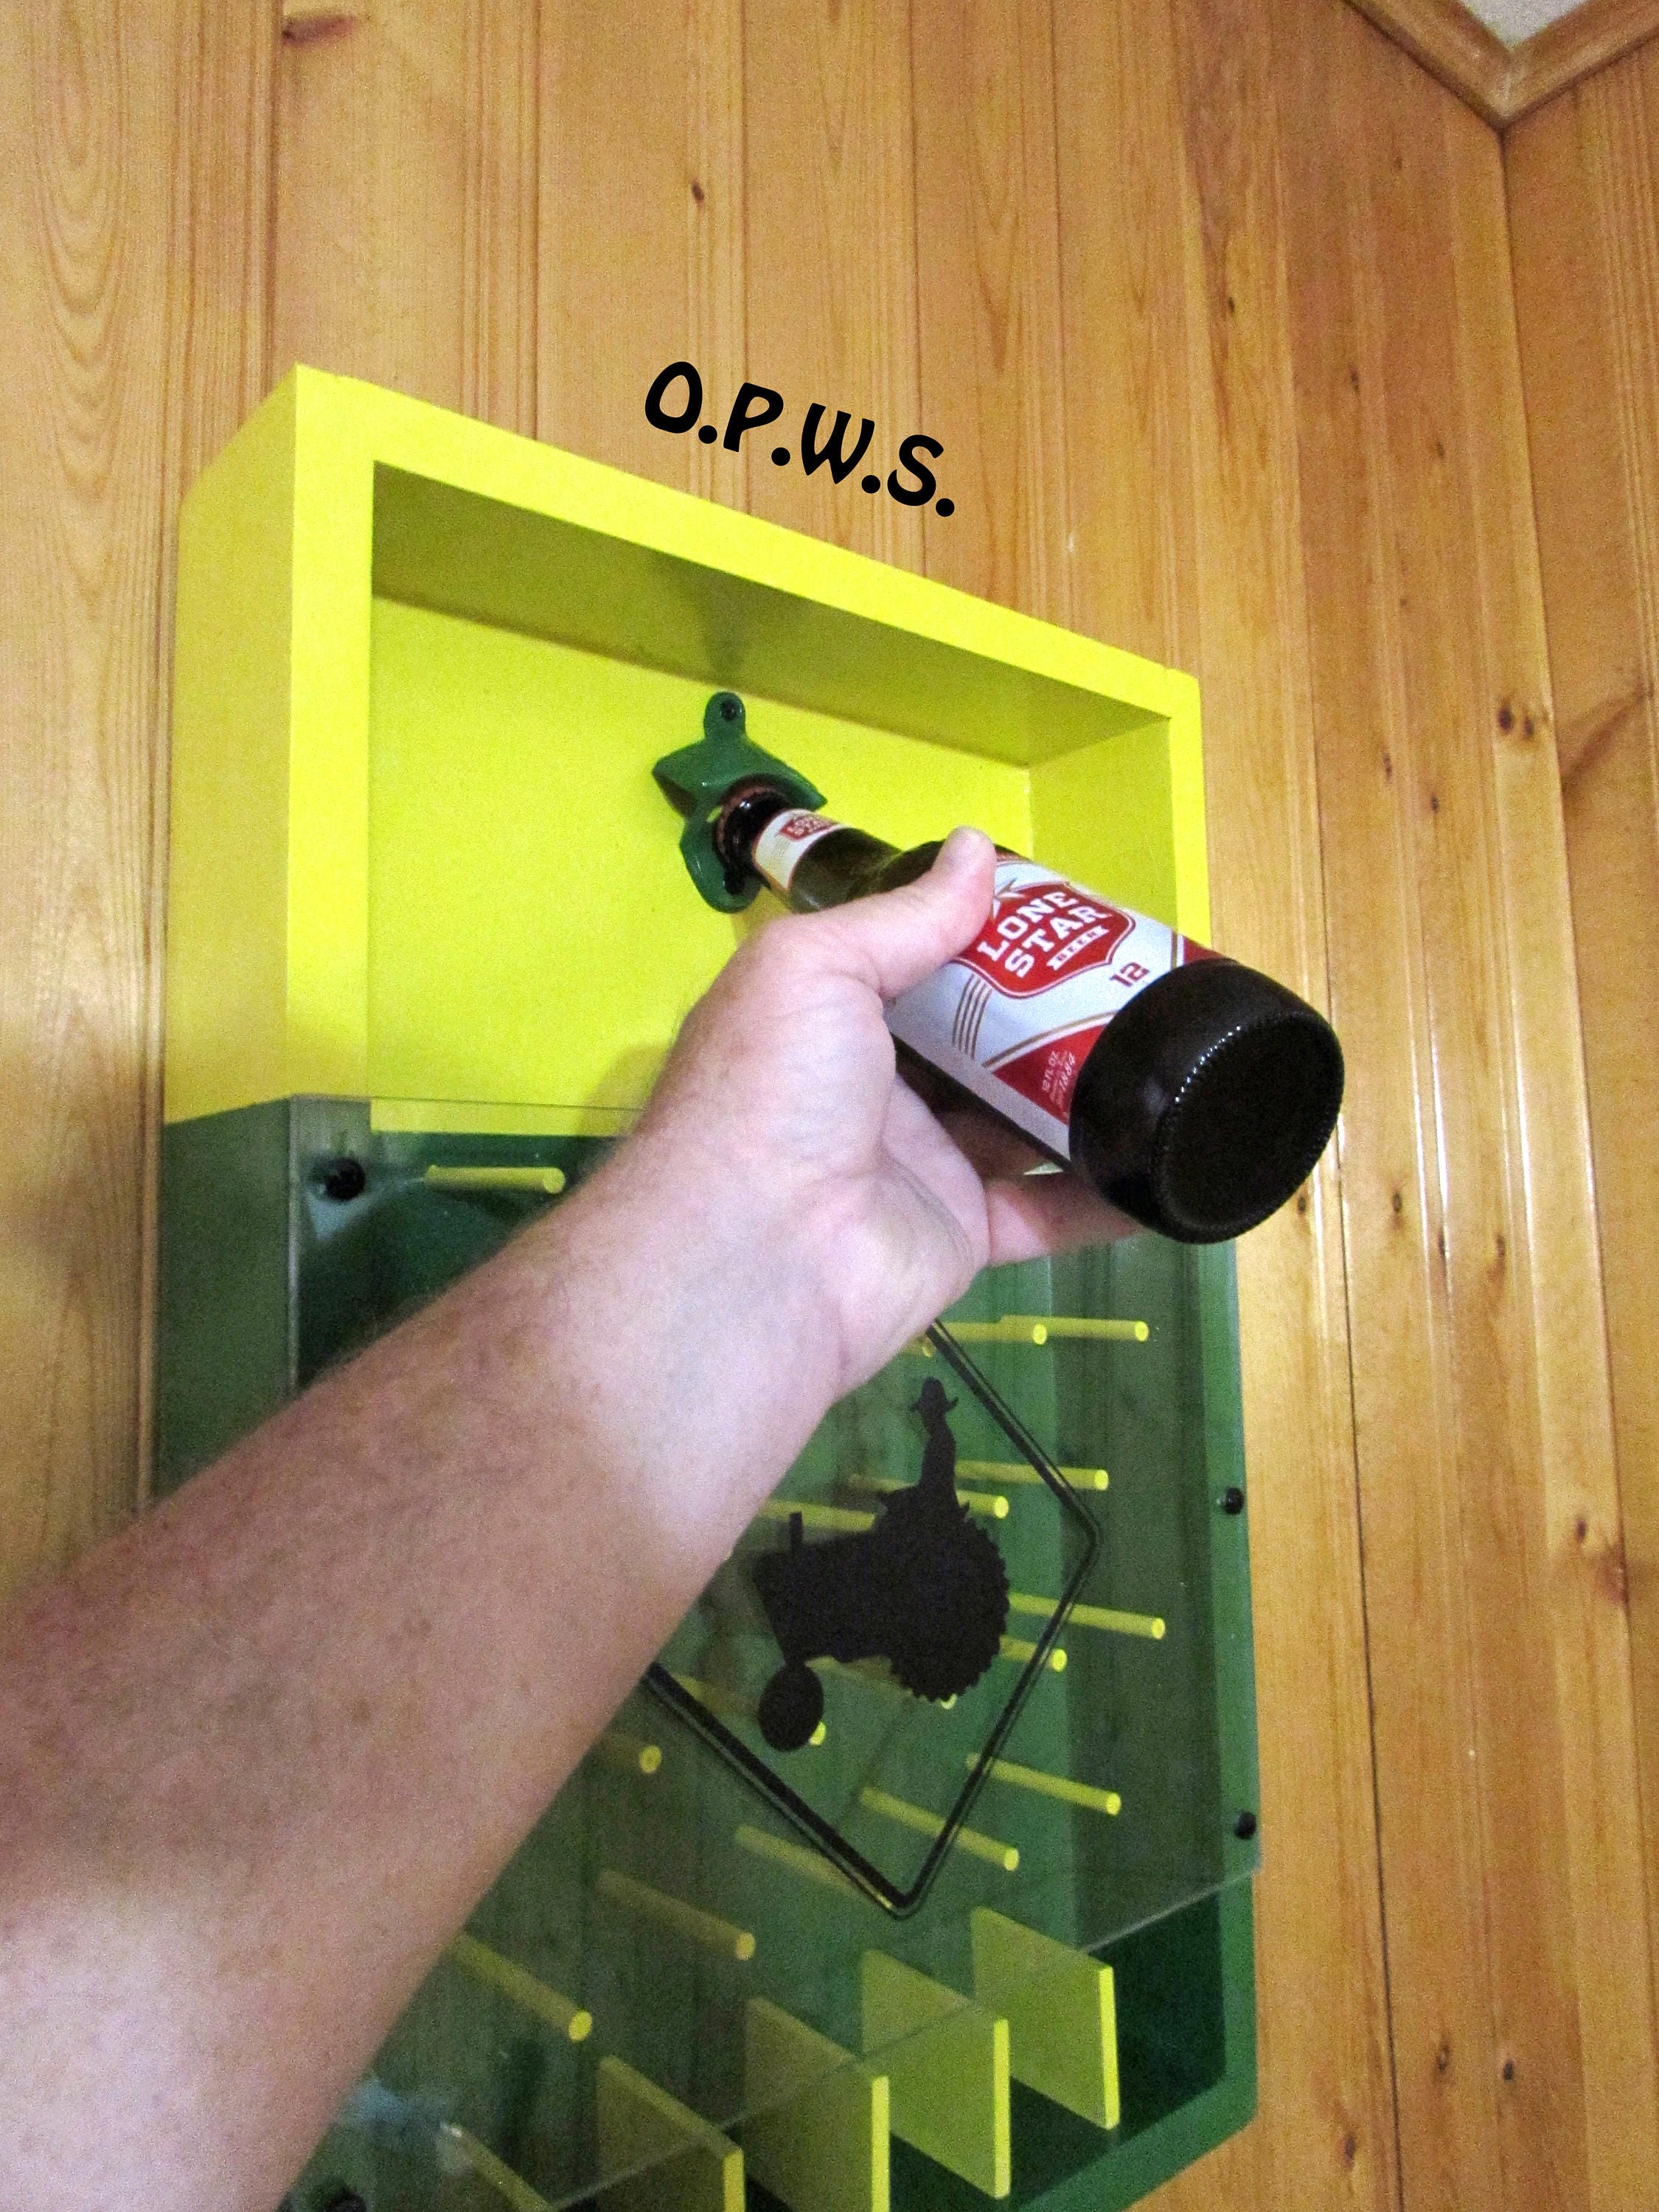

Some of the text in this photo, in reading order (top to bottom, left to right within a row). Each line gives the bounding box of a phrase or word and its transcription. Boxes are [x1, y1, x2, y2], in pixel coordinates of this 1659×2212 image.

[977, 891, 1079, 962] LONE
[1005, 905, 1113, 978] STAR
[1056, 930, 1099, 962] BEER
[1110, 961, 1150, 987] 12
